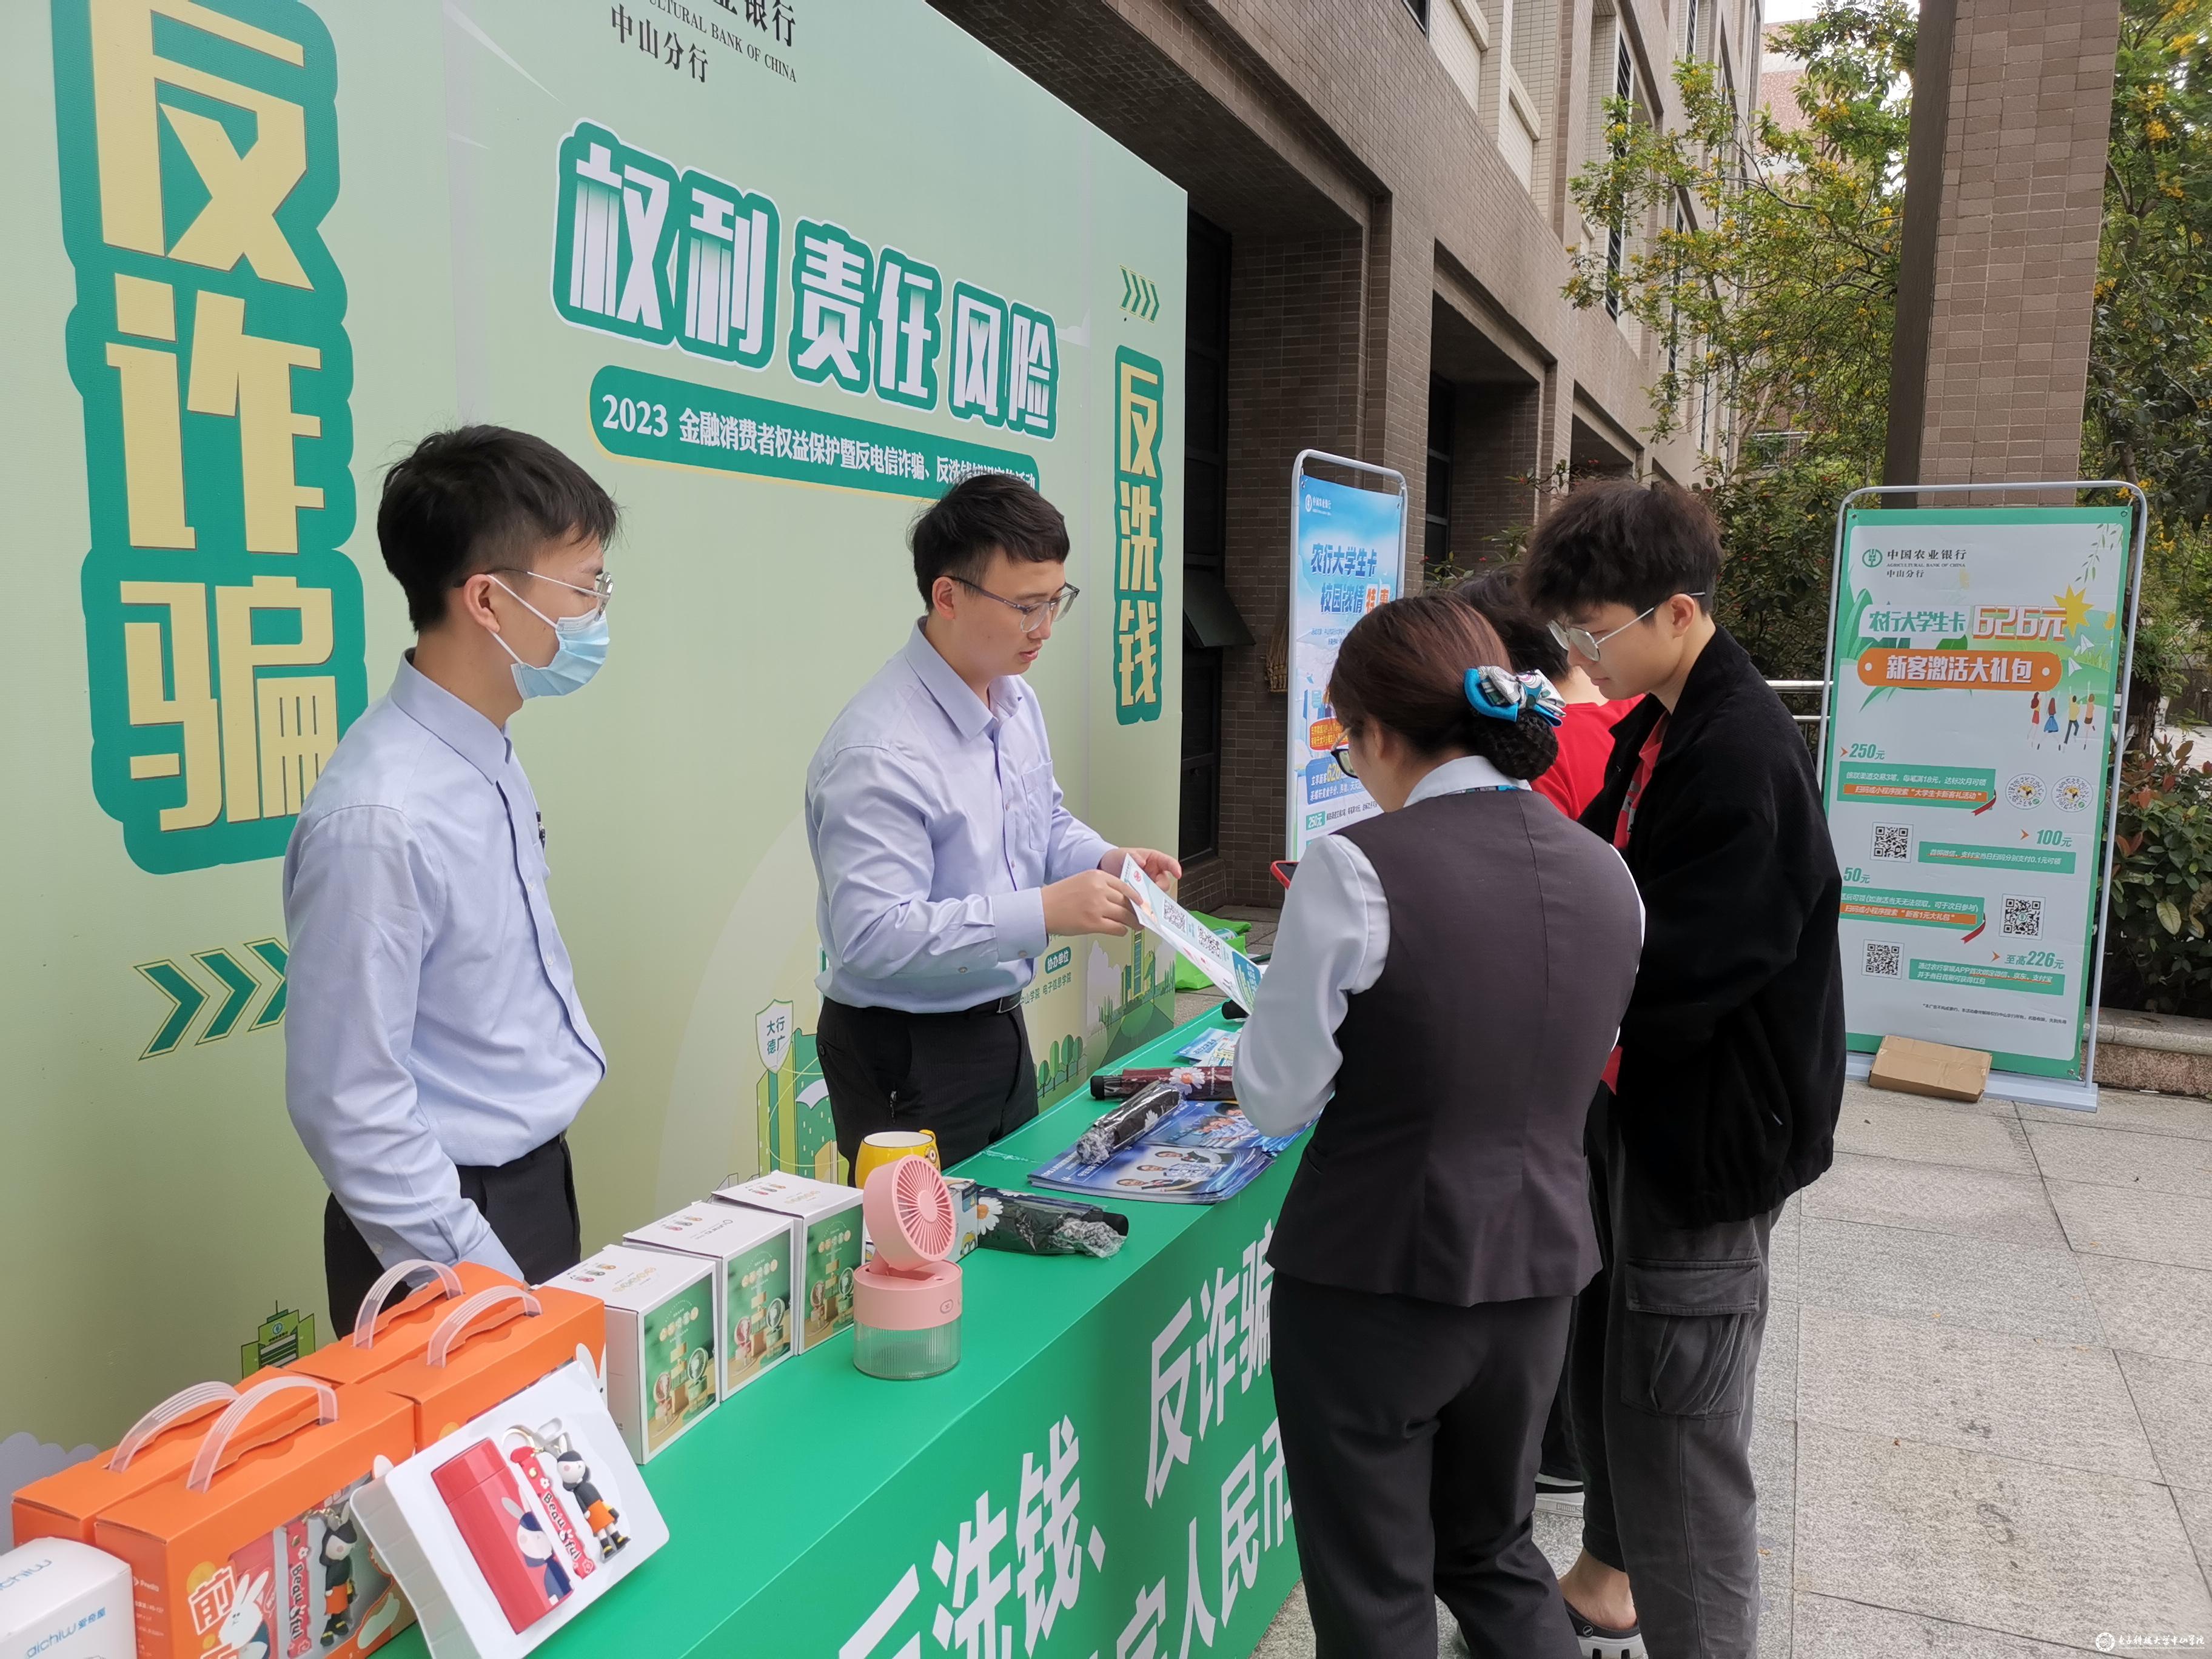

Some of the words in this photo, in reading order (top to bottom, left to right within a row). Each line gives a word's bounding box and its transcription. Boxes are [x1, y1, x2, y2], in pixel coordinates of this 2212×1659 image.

[611, 4, 708, 83] 中山分行
[711, 22, 743, 53] BANK
[746, 44, 761, 62] OF
[765, 53, 797, 83] CHINA
[569, 142, 768, 355] 权利
[797, 235, 933, 399] 责任
[953, 293, 1051, 429] 风险
[89, 0, 340, 832] 反诈骗
[602, 394, 668, 438] 2023
[1118, 361, 1158, 706] 反洗钱
[1310, 543, 1378, 578] 农行大学生卡
[1887, 549, 1966, 560] 中国农业银行
[1868, 611, 1966, 632] 农行大学生卡
[1972, 605, 2068, 641] 626元
[1886, 655, 2033, 683] 新客激活大礼包
[1849, 743, 1885, 760] 250元
[2036, 829, 2073, 847] 100元
[1047, 950, 1069, 971] 协办单位
[2004, 951, 2065, 969] 至高226元
[1042, 971, 1071, 995] 电子信息学院
[766, 1016, 785, 1036] 大行
[767, 1035, 786, 1055] 德广
[78, 1607, 106, 1630] 爱奇屋
